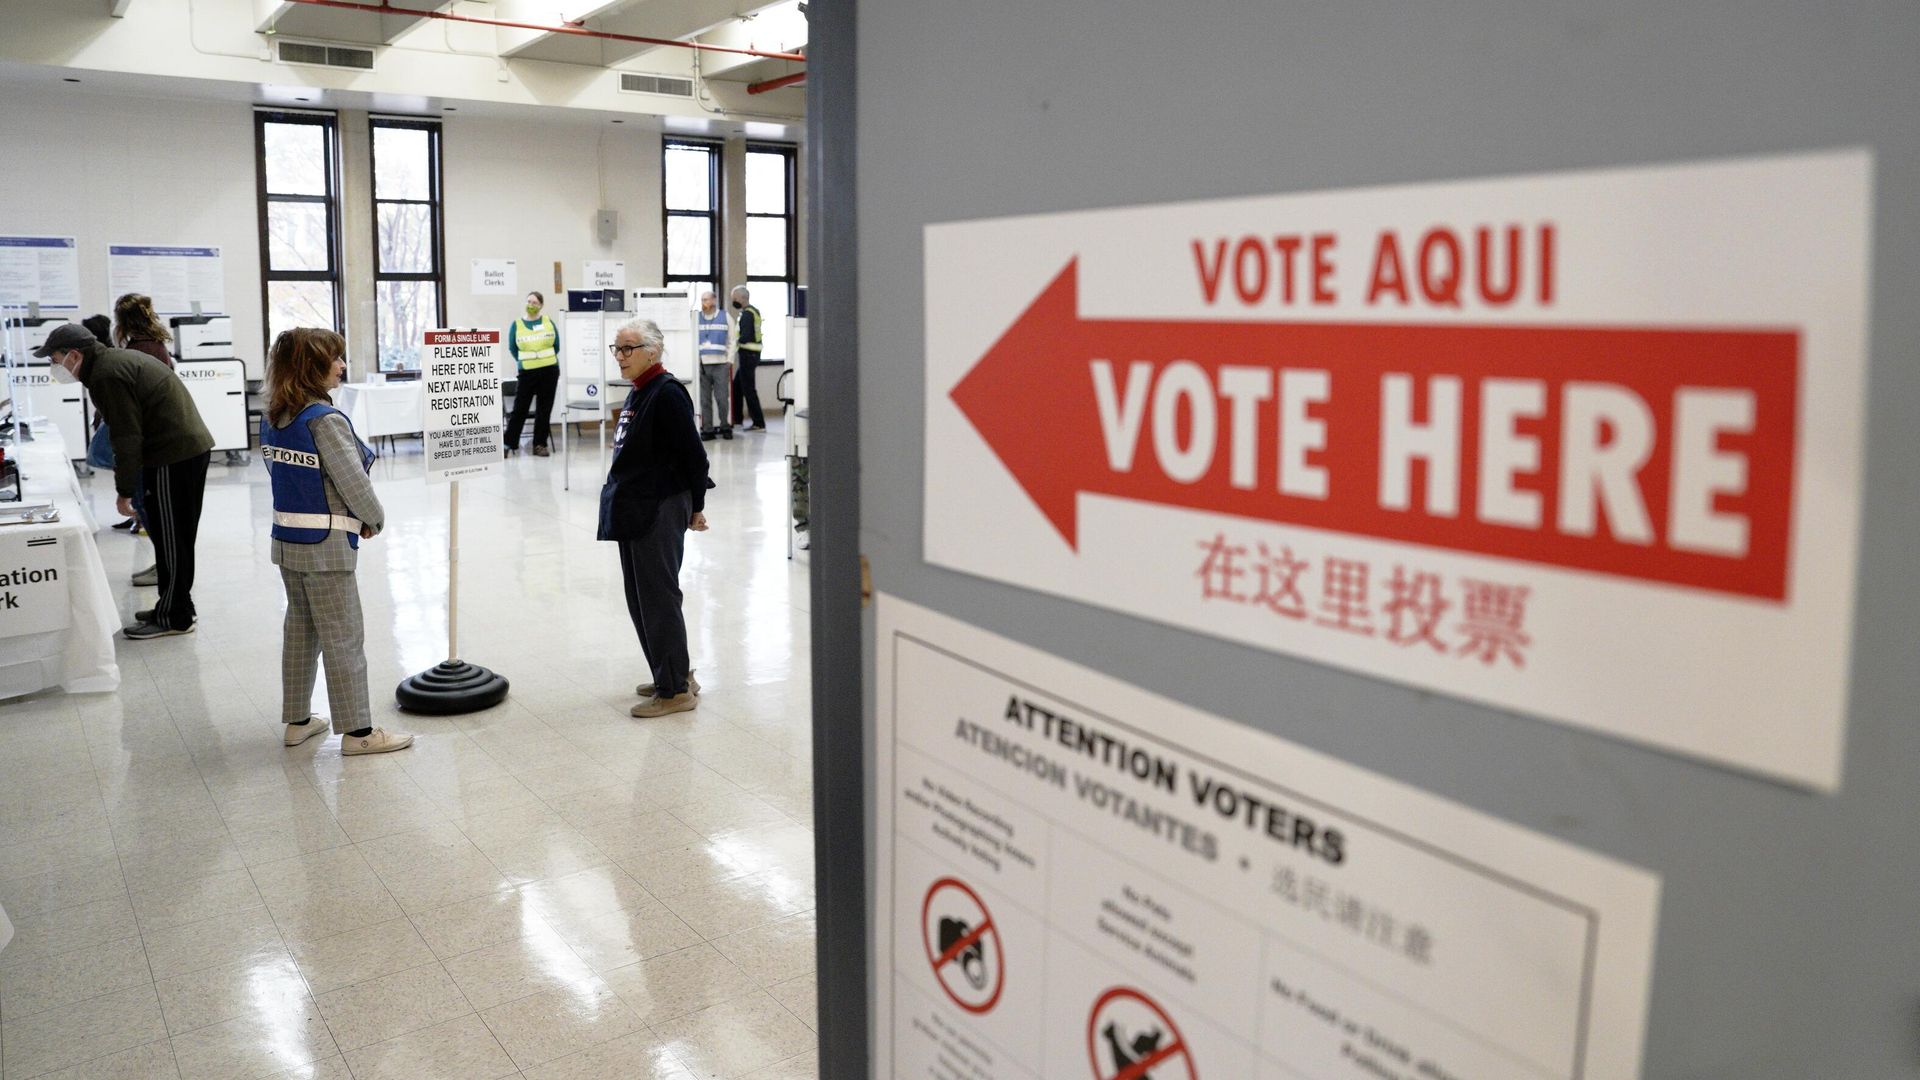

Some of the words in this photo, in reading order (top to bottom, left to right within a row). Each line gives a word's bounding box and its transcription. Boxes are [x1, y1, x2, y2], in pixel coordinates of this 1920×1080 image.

[1191, 233, 1338, 307] VOTE
[1363, 222, 1557, 309] AQUI
[484, 270, 504, 278] Ballot
[595, 279, 614, 287] Clerks
[434, 334, 451, 343] FORM
[451, 334, 457, 342] A
[457, 334, 477, 342] SINGLE
[477, 333, 491, 342] LINE
[434, 346, 468, 358] PLEASE
[470, 346, 491, 357] WAIT
[179, 370, 216, 378] SENTIO
[431, 363, 456, 376] HERE
[458, 363, 476, 375] FOR
[478, 362, 494, 373] THE
[427, 381, 451, 393] NEXT
[453, 378, 498, 392] AVAILABLE
[431, 395, 494, 410] REGISTRATION
[450, 412, 480, 426] CLERK
[429, 431, 441, 440] YOU
[441, 430, 453, 438] ARE
[454, 429, 465, 438] NOT
[466, 426, 492, 436] REQUIRED
[493, 425, 500, 433] TO
[439, 440, 454, 448] HAVE
[462, 438, 473, 446] BUT
[479, 436, 492, 444] WILL
[434, 450, 453, 460] SPEED
[461, 448, 472, 456] THE
[472, 445, 497, 454] PROCESS
[1089, 360, 1332, 501] VOTE
[1378, 371, 1758, 560] HERE
[0, 567, 58, 587] ation
[1194, 531, 1533, 671] 在这里投票
[1004, 695, 1177, 794] ATTENTION
[1188, 771, 1348, 867] VOTERS
[954, 718, 1068, 791] ATENCION
[1073, 771, 1220, 862] VOTANTES
[965, 798, 1014, 838] Recording
[1271, 865, 1436, 968] 选民请注意
